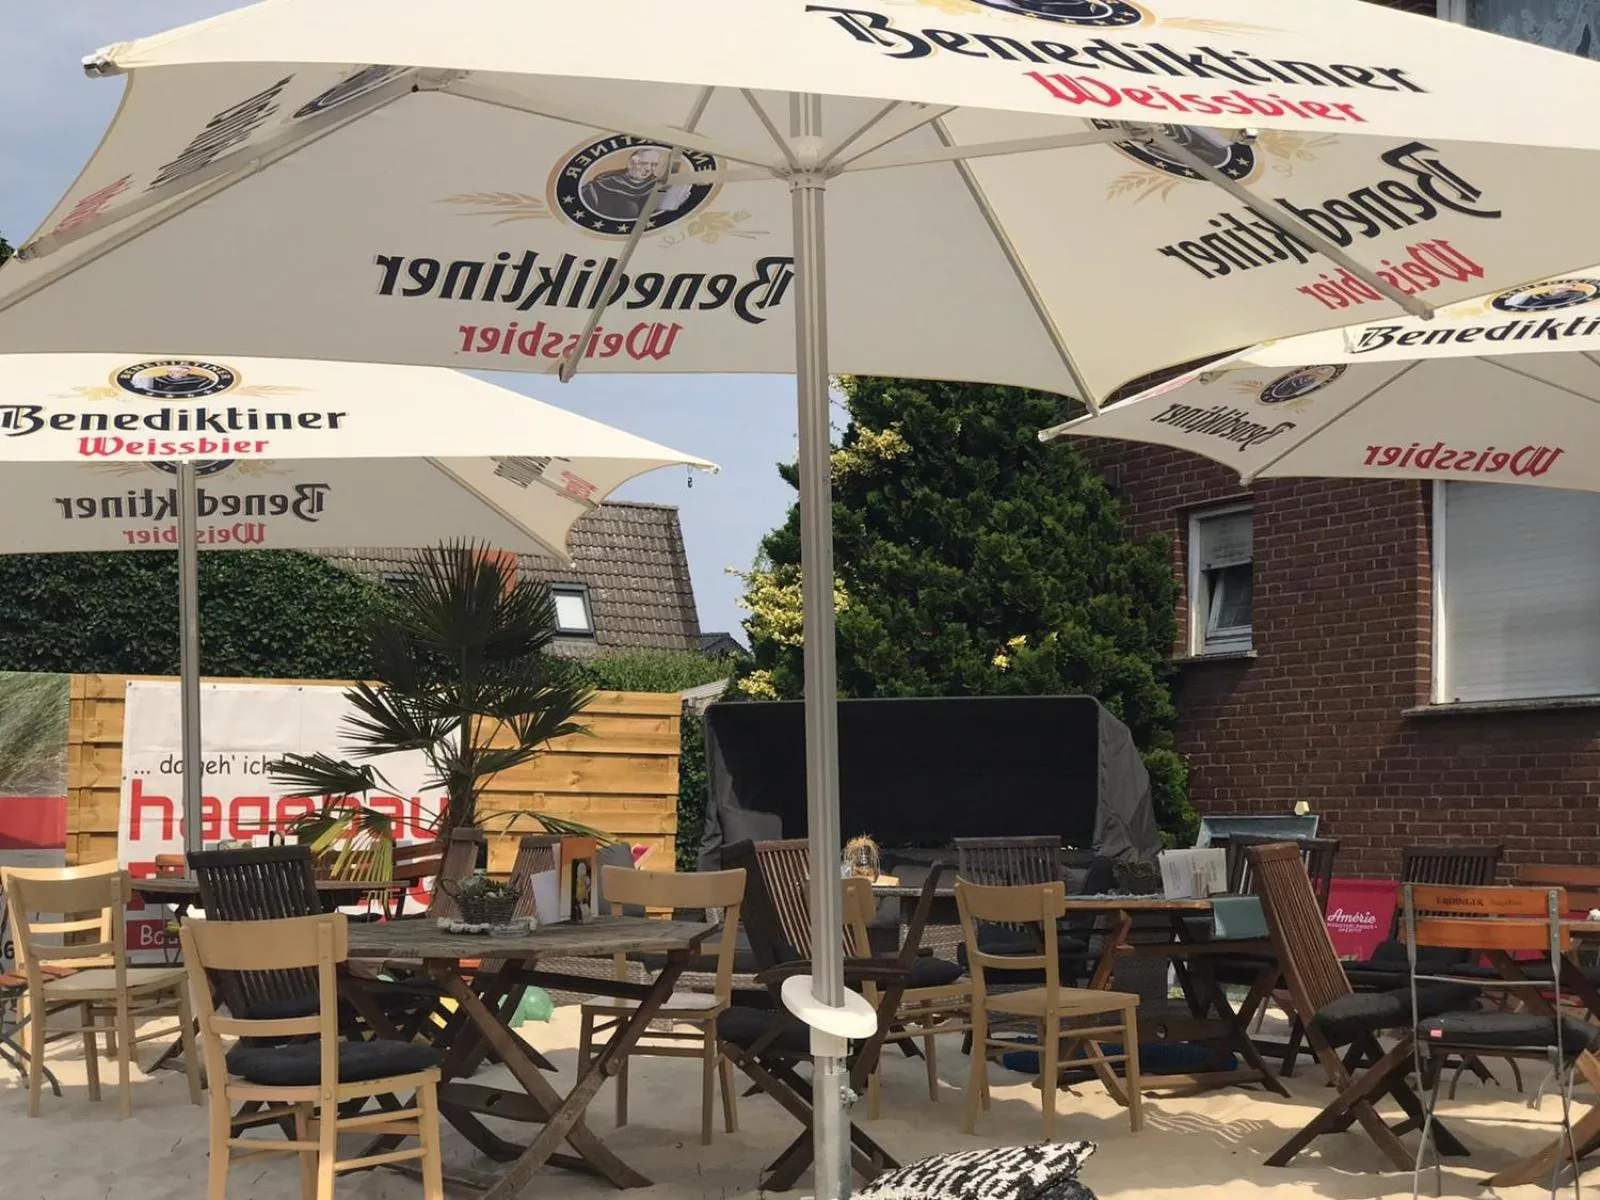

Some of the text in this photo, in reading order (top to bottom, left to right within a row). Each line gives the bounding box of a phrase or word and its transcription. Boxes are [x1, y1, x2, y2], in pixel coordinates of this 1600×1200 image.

[806, 5, 1424, 95] Benediktiner
[1023, 70, 1368, 123] Weissbier
[0, 405, 347, 437] Benediktiner
[77, 436, 269, 456] Weissbier
